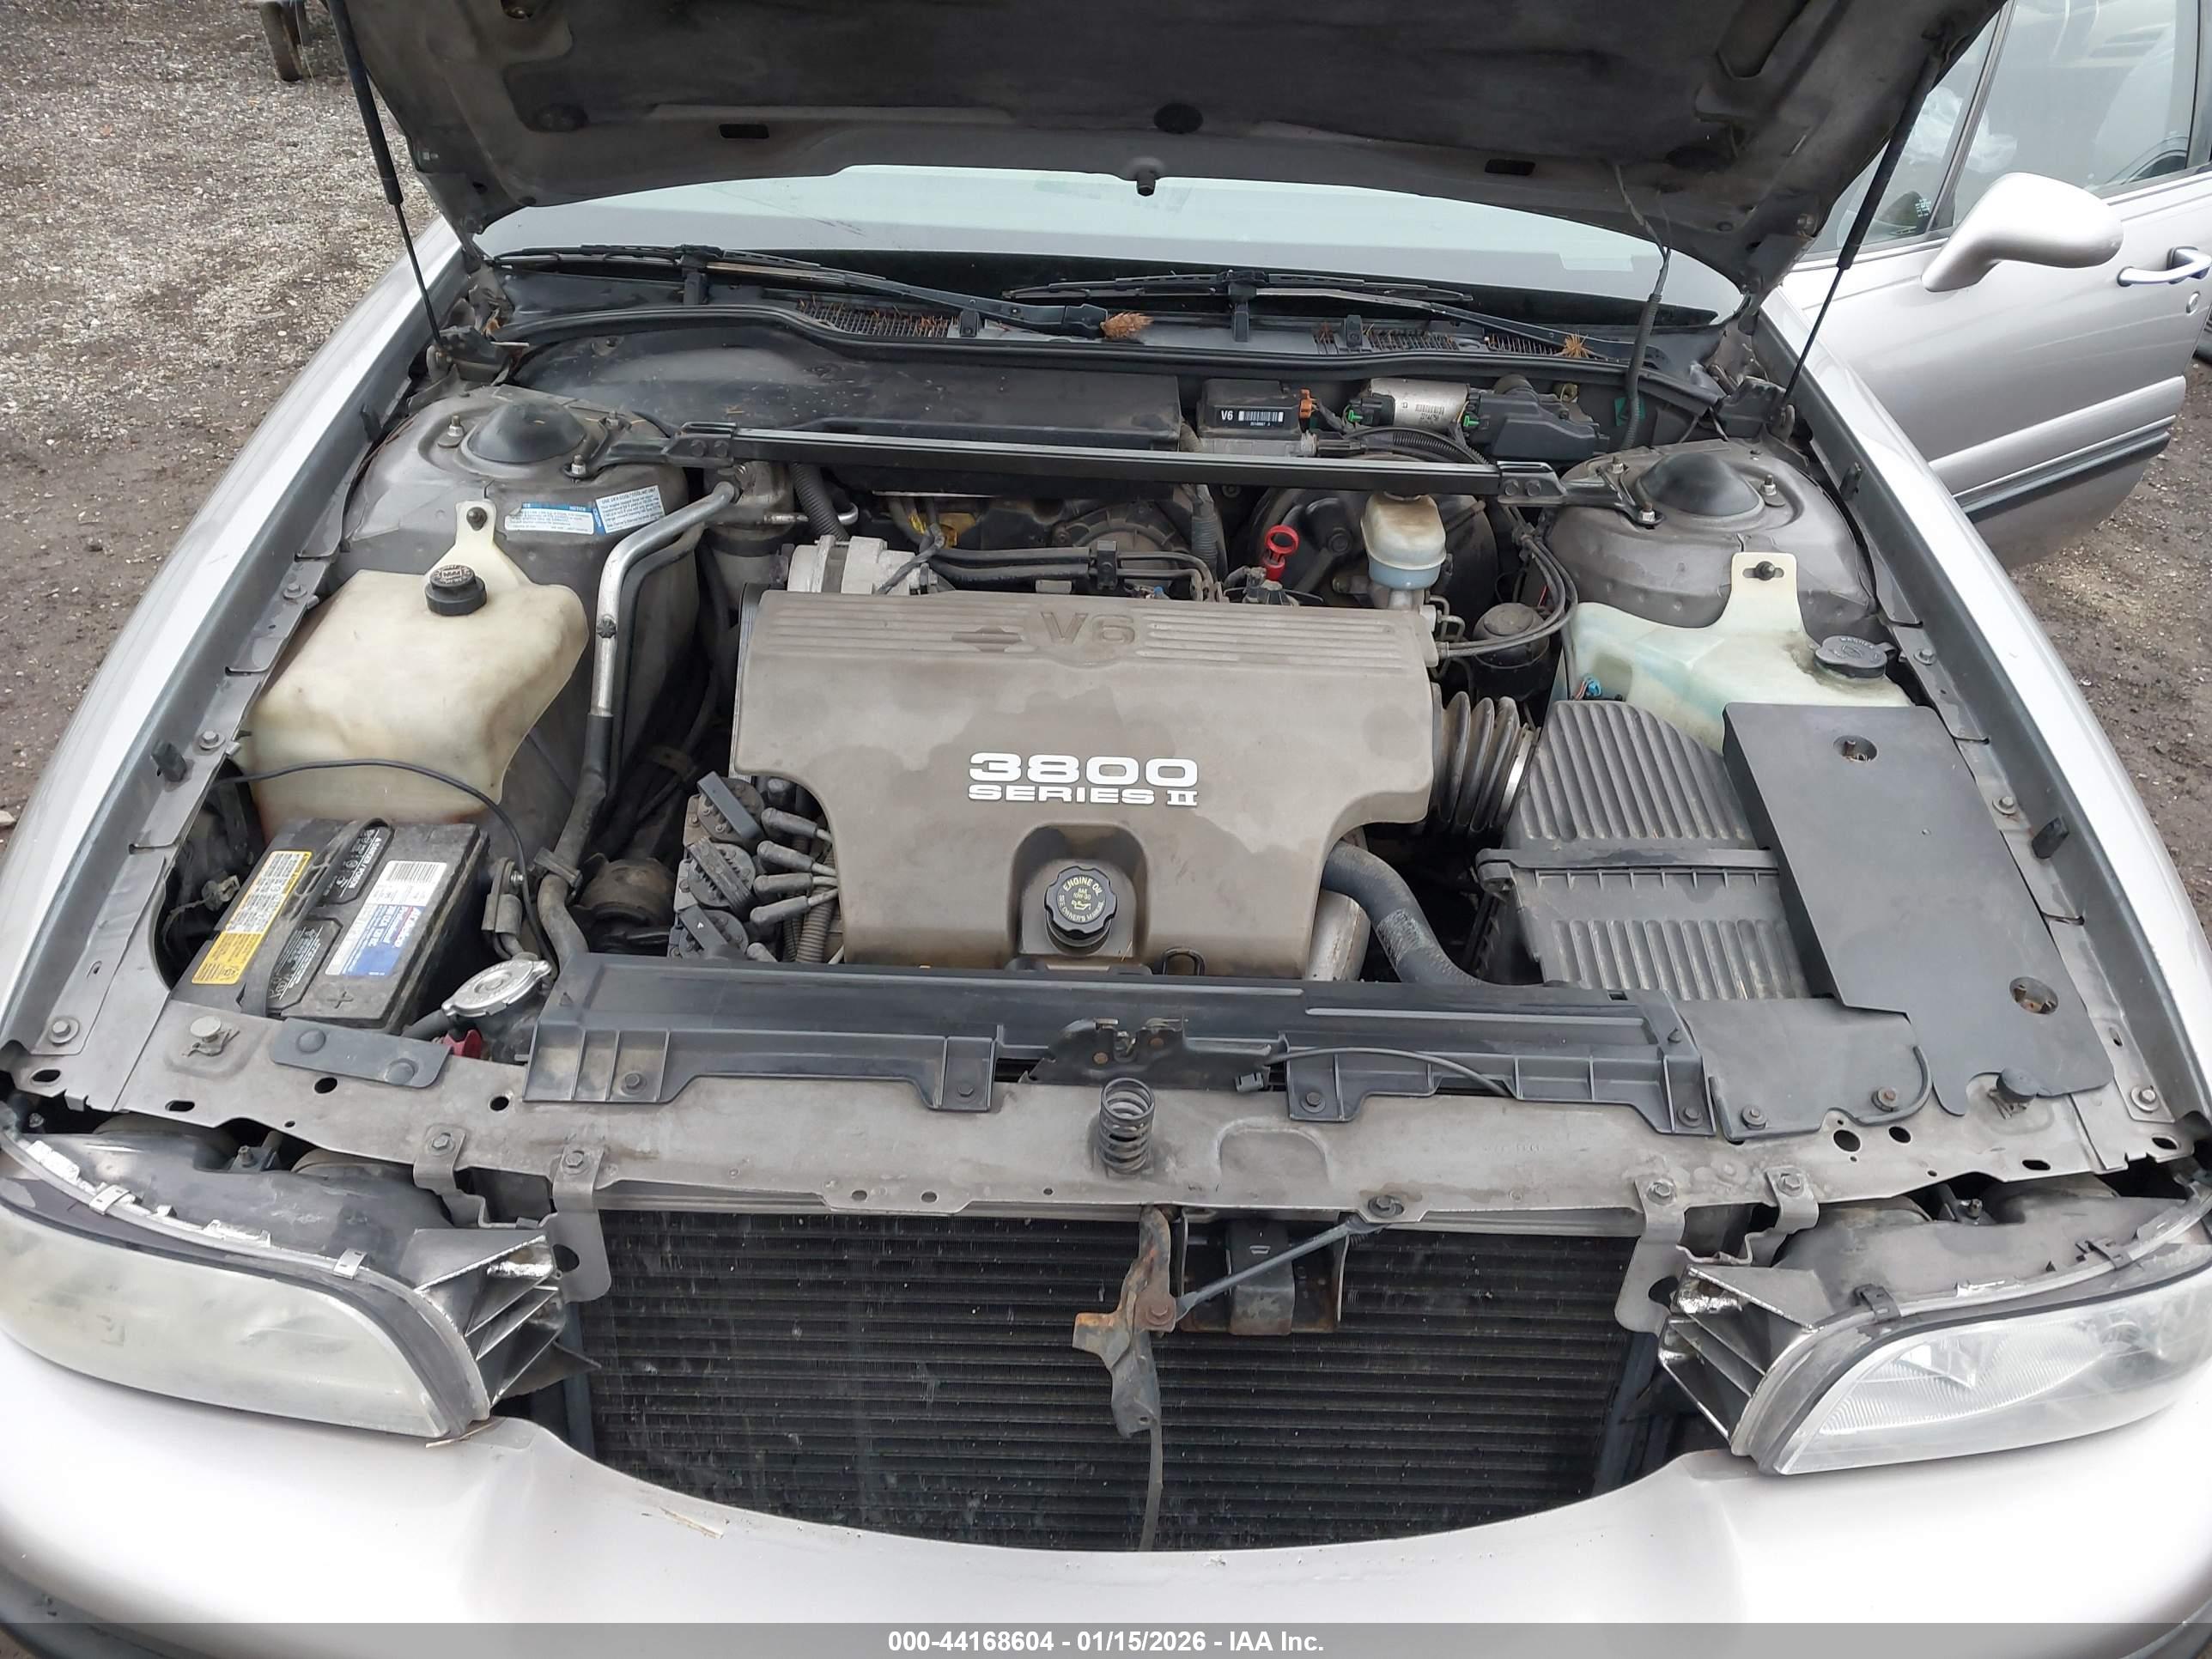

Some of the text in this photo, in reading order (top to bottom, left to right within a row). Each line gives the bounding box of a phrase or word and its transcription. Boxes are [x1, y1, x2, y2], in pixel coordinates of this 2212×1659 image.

[1220, 410, 1234, 421] V6
[1040, 611, 1136, 646] V6
[968, 751, 1199, 787] 3800
[968, 784, 1199, 806] SERIES II
[1062, 876, 1103, 896] ENGINE OIL
